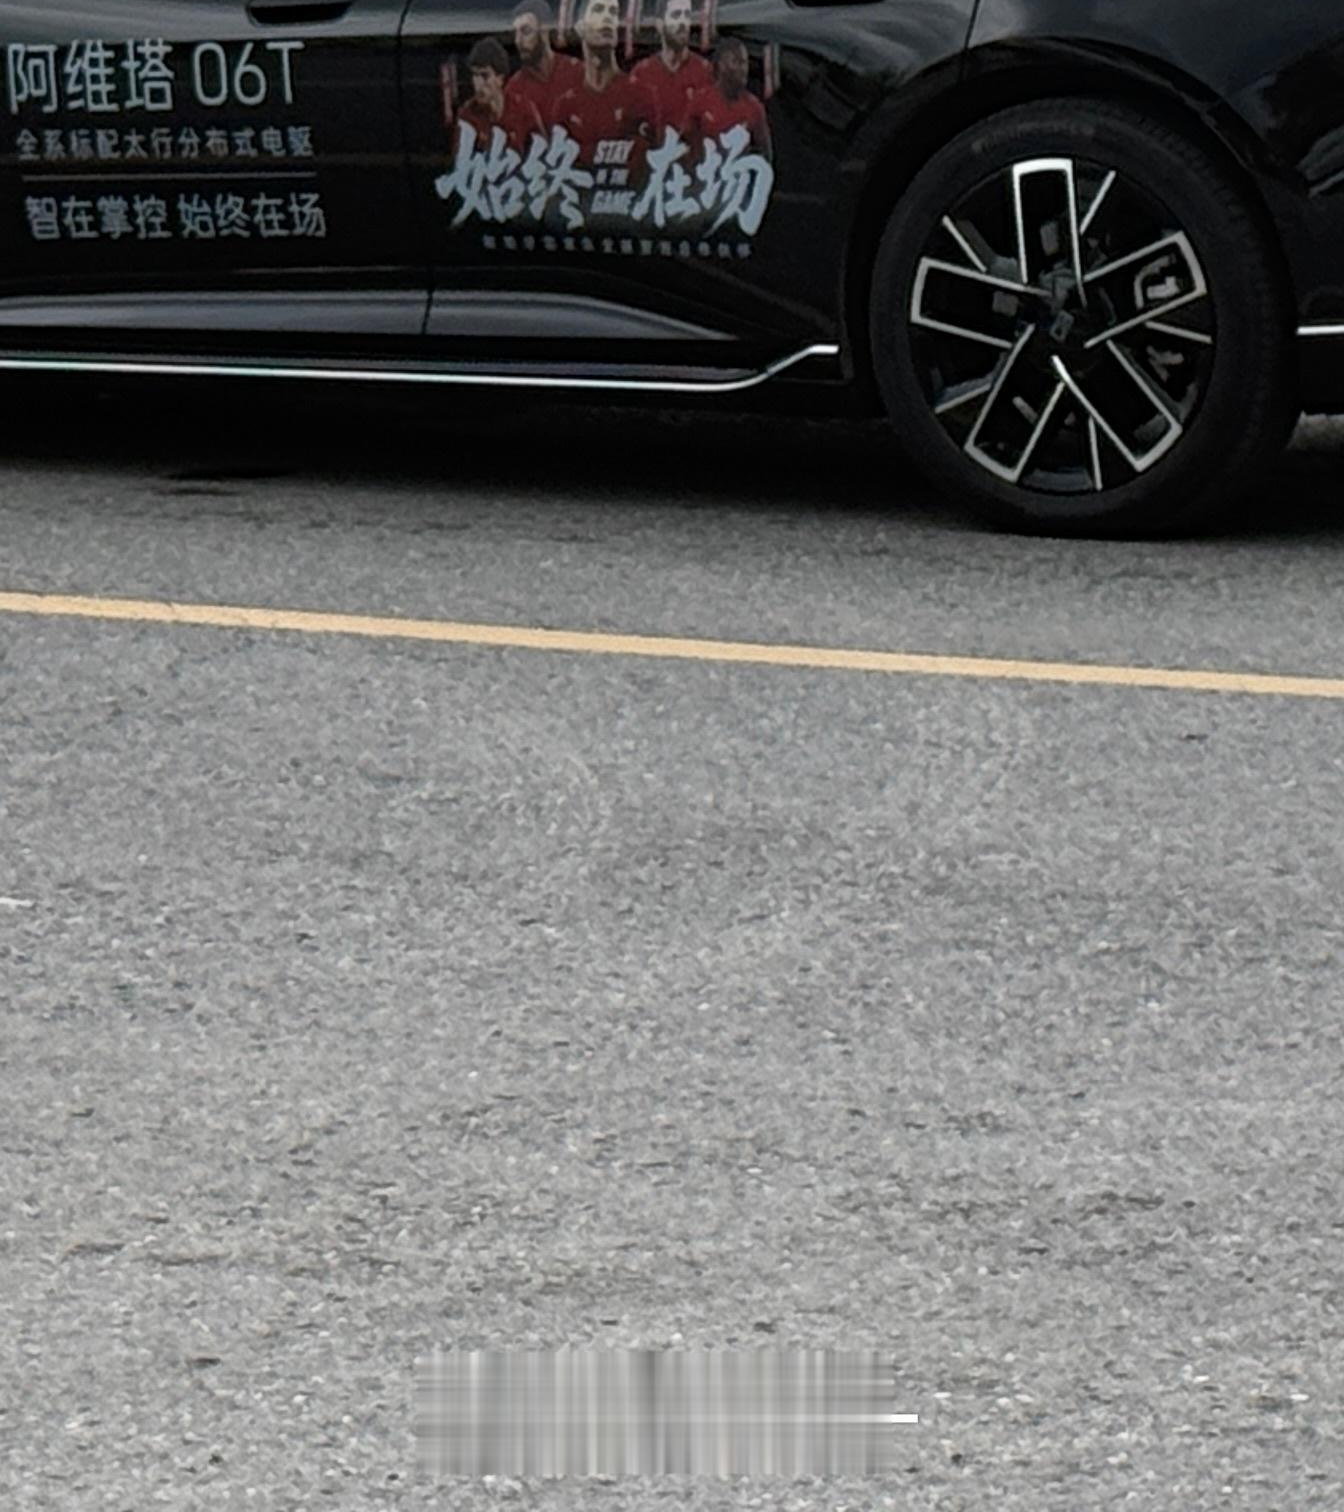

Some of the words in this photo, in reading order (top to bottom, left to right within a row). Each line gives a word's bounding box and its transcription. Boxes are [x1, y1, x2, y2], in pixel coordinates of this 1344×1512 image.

[6, 38, 174, 115] 阿维塔
[194, 40, 305, 106] 06T
[24, 194, 173, 240] 智在掌控
[177, 192, 327, 239] 始终在场
[434, 117, 594, 231] 始终
[632, 122, 774, 238] 在场
